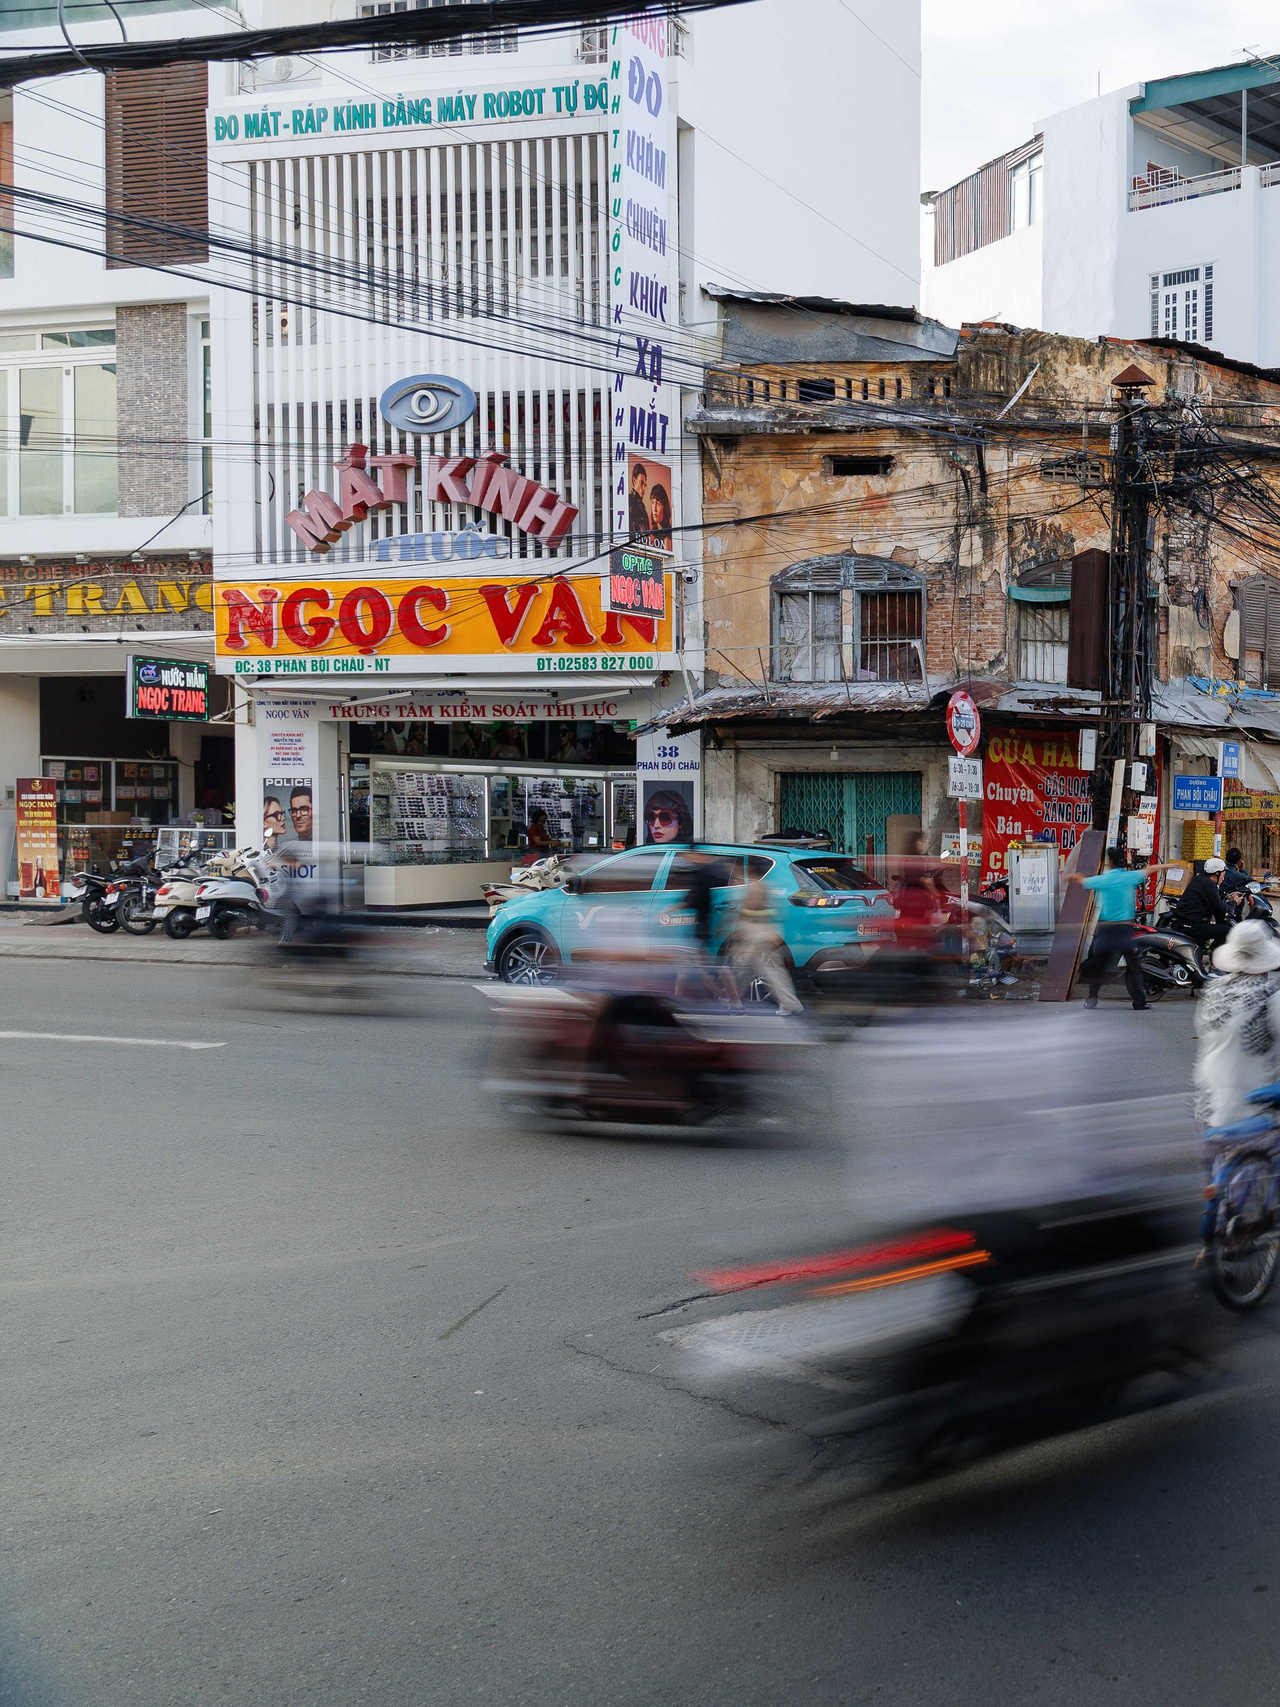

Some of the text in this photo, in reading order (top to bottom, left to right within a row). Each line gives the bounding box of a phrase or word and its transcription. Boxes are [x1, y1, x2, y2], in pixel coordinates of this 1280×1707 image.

[627, 56, 663, 118] ĐO
[215, 115, 239, 141] ĐO
[334, 99, 376, 131] KÍNH
[382, 92, 431, 127] BẰNG
[438, 89, 477, 122] MÁY
[484, 88, 546, 119] ROBOT
[552, 79, 580, 117] TỰ
[626, 129, 666, 190] KHÁM
[626, 198, 667, 257] CHUYÊN
[629, 271, 668, 323] KHÚC
[635, 337, 663, 393] XẠ
[629, 398, 669, 455] MẮT
[285, 442, 579, 554] MẮT KÍNH
[375, 520, 510, 562] THUỐC
[622, 553, 653, 575] OPTIC
[611, 575, 664, 611] NGỌC VÂN
[222, 586, 452, 656] NGỌC
[235, 660, 254, 673] ĐC:
[257, 659, 271, 673] 38
[275, 659, 307, 673] PHAN
[310, 657, 330, 674] BỘI
[333, 657, 365, 672] CHÂU
[375, 658, 390, 671] NT
[601, 657, 625, 670] 827
[629, 656, 653, 669] 000
[161, 667, 205, 688] NƯỚC MẮM
[138, 686, 206, 714] NGỌC TRANG
[329, 698, 618, 720] TRUNG TÂM KIỂM SOÁT THỊ LỰC
[266, 708, 310, 720] NGỌC VÂN
[657, 746, 679, 758] 38
[988, 729, 1036, 766] CỬA
[637, 760, 700, 772] PHAN BỘI CHÂU
[265, 778, 312, 786] POLICE
[987, 781, 1035, 805] Chuyên
[1044, 772, 1065, 797] CÁC
[1177, 788, 1191, 801] PHAN
[1193, 786, 1201, 803] BỘI
[1204, 787, 1217, 802] CHÂU
[1043, 798, 1073, 822] XĂNG
[997, 815, 1022, 836] Bán
